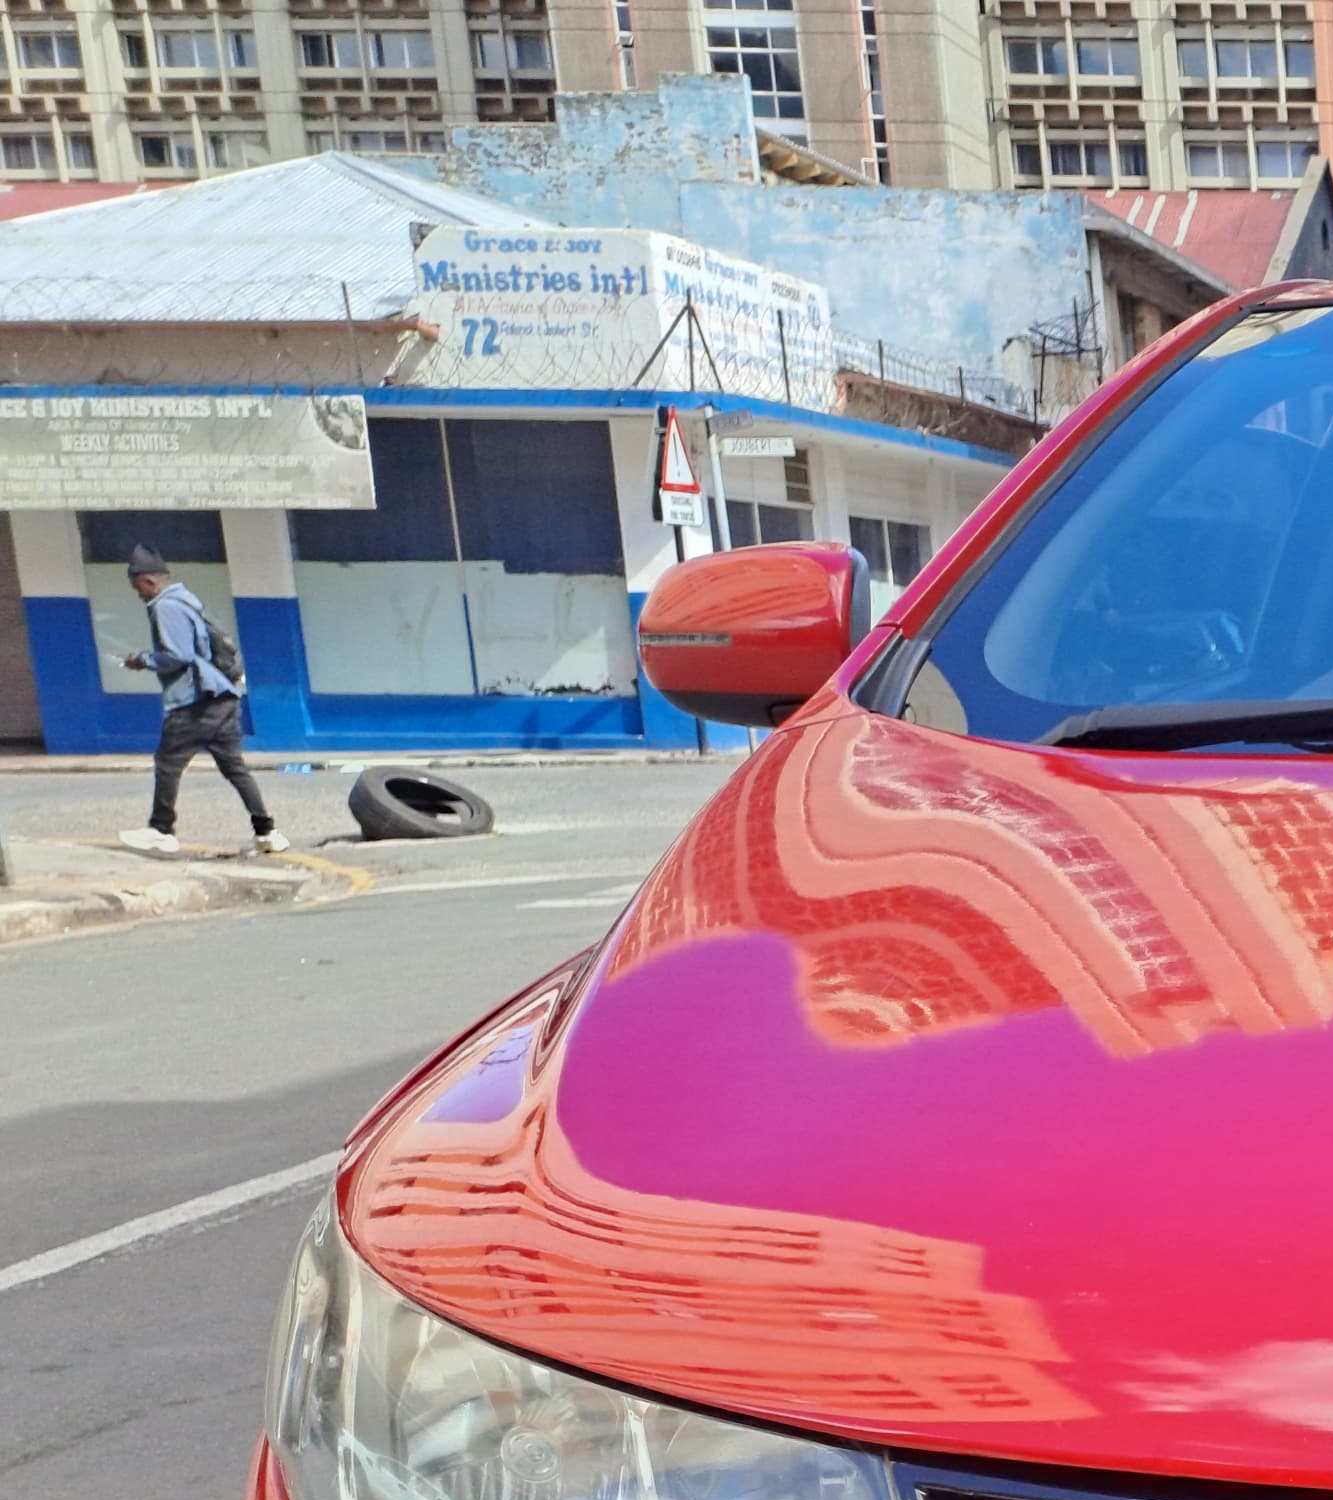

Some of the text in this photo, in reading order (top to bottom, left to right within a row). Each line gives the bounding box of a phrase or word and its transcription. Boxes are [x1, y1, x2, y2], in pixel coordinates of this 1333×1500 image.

[464, 230, 538, 253] Grace
[420, 260, 582, 293] Ministries
[461, 316, 502, 358] 72
[51, 398, 84, 418] JOY
[90, 398, 211, 418] MINISTRIES
[61, 433, 180, 452] WEEKLY ACTIVITIES
